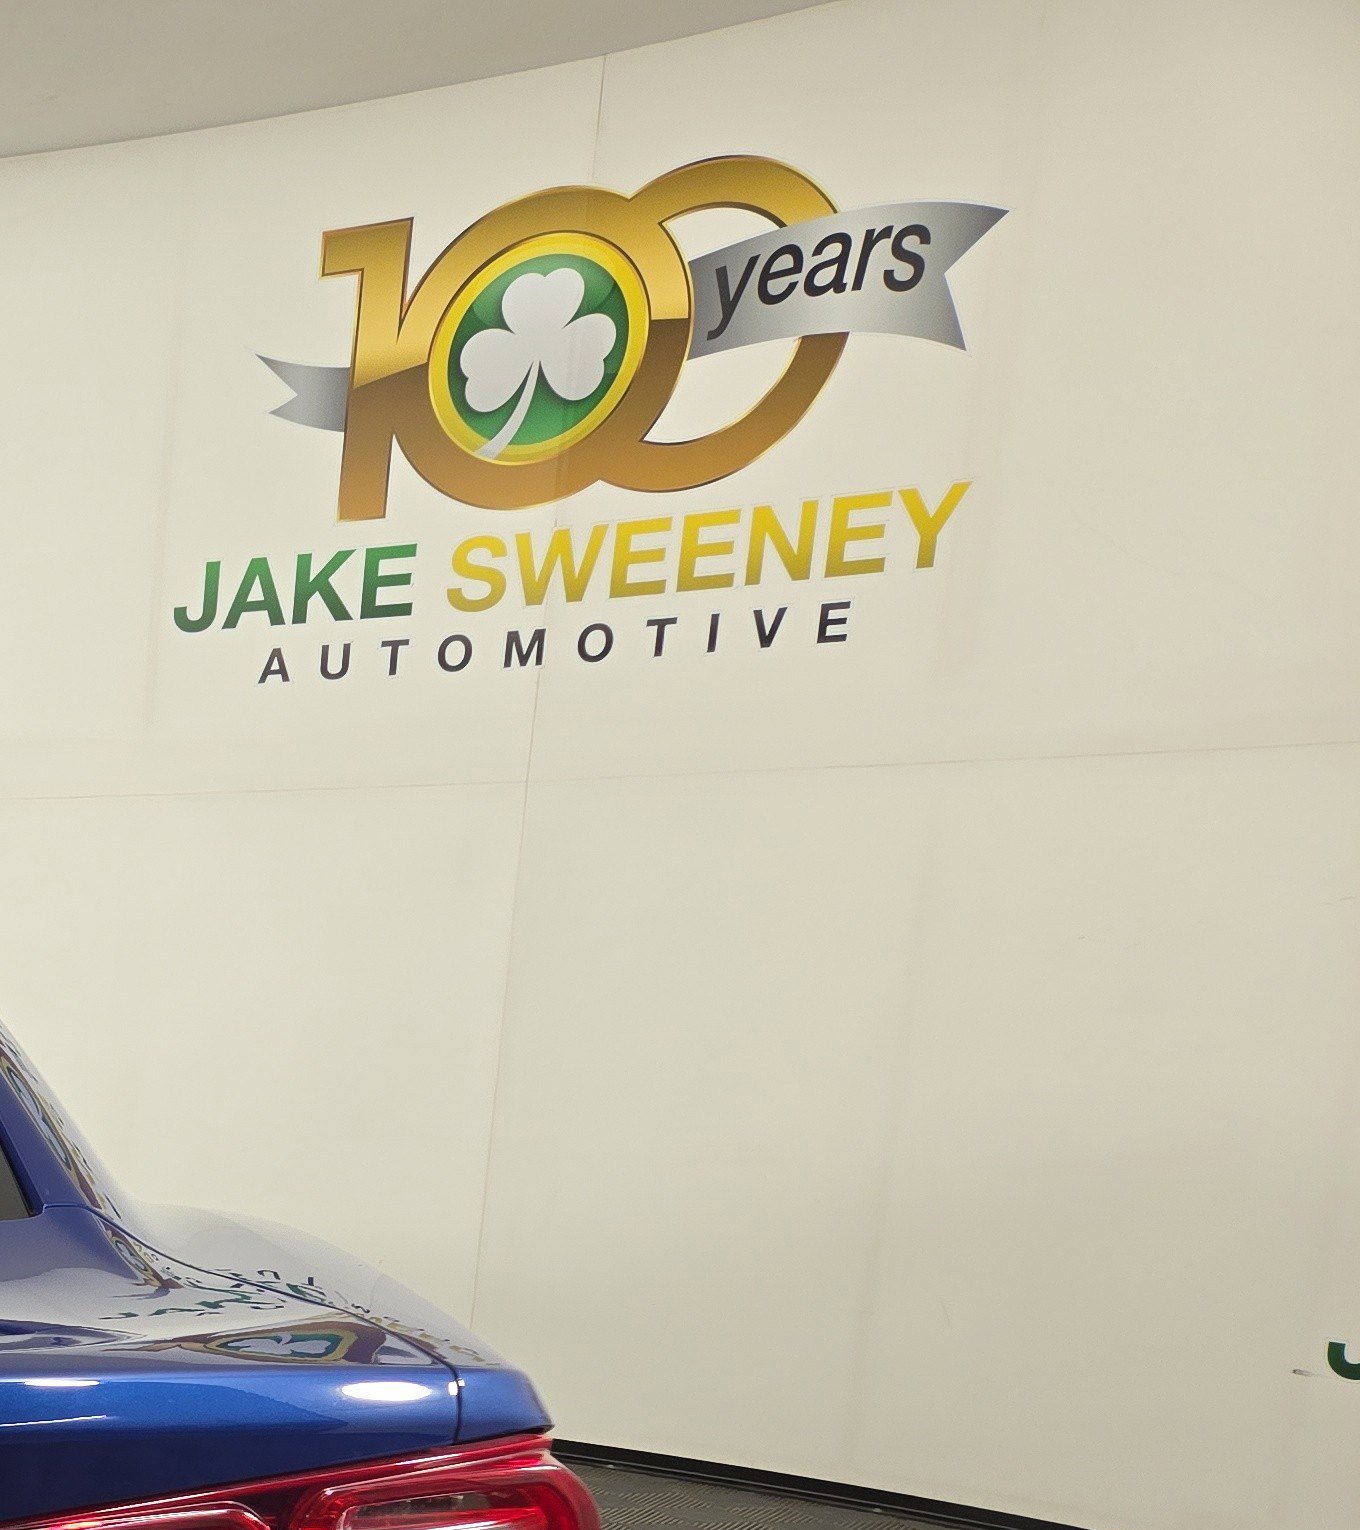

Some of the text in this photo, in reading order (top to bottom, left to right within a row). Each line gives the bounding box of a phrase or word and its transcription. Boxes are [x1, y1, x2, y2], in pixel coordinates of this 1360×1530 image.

[319, 155, 933, 522] 100 years
[174, 481, 973, 634] JAKE SWEENEY
[259, 601, 852, 686] AUTOMOTIVE
